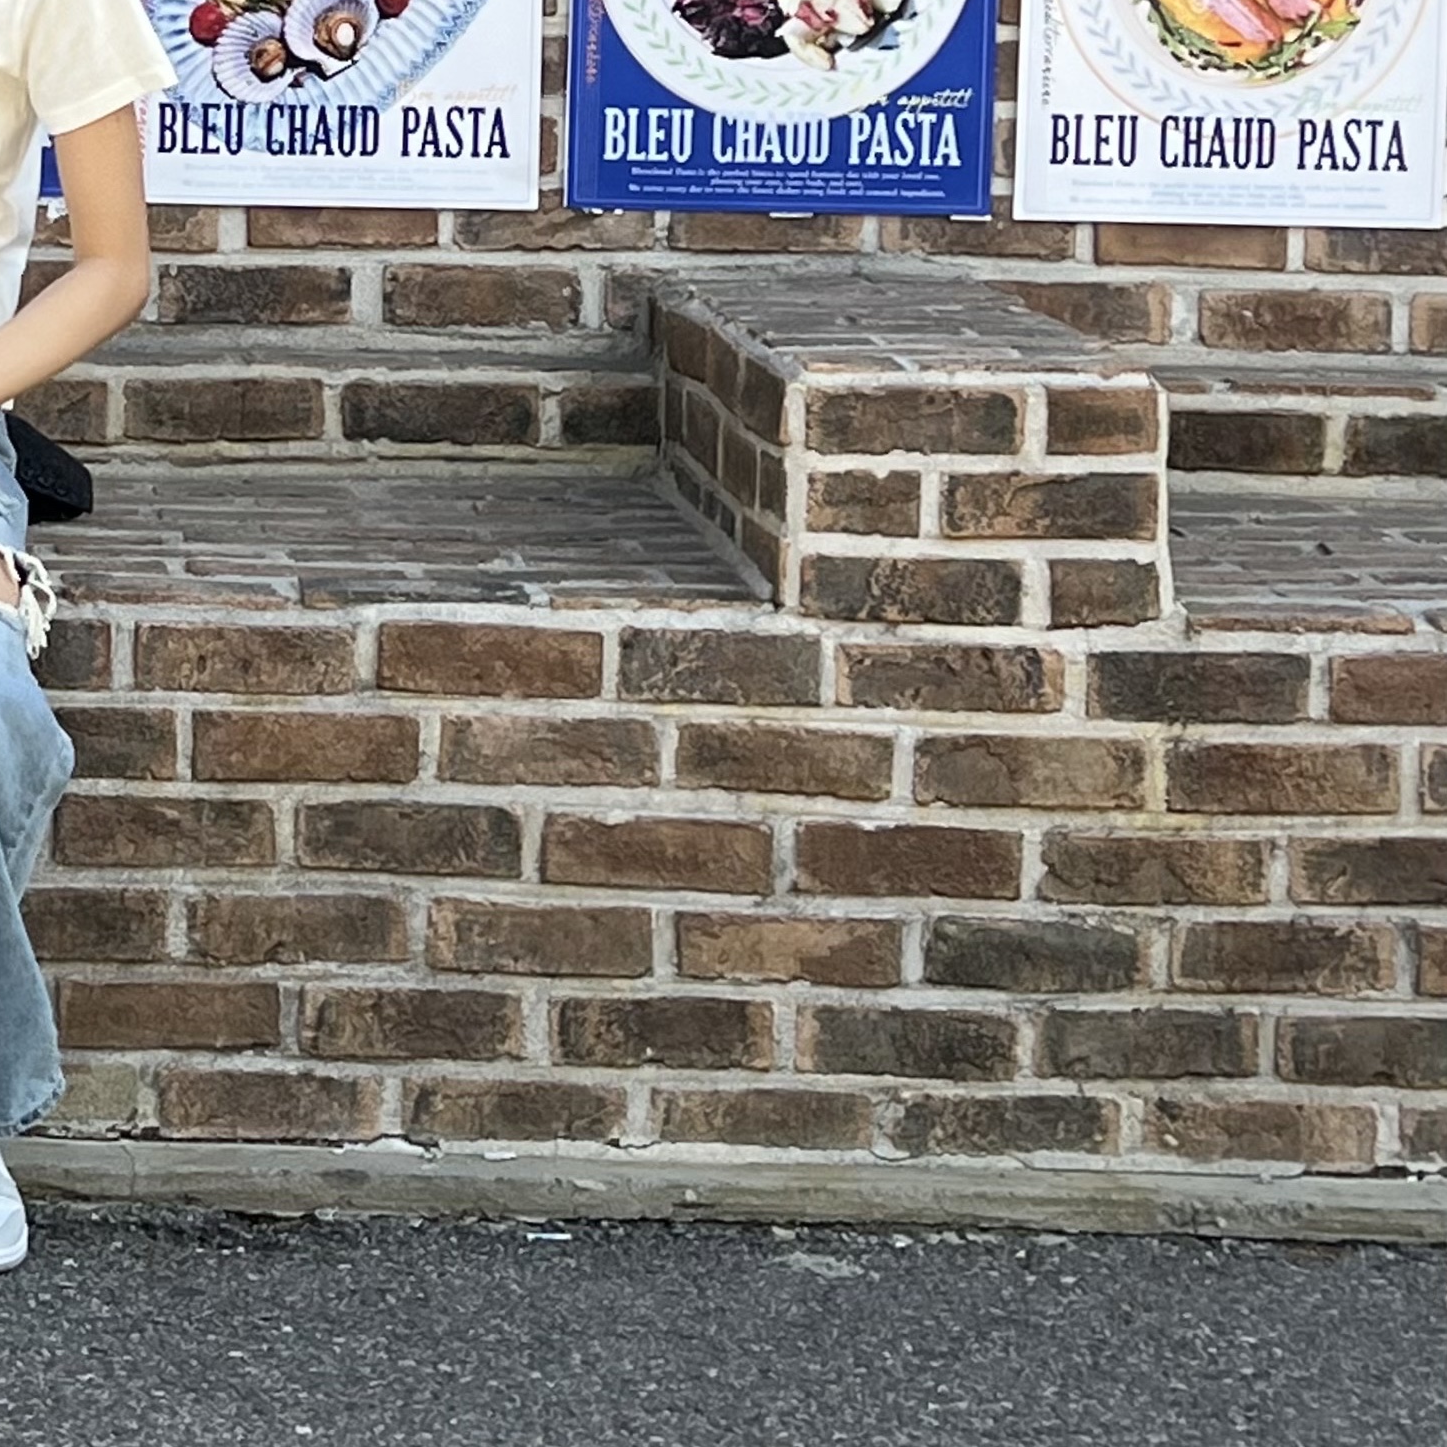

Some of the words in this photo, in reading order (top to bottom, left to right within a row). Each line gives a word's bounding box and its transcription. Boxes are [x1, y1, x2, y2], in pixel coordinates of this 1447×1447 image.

[157, 102, 245, 155] BLEU
[264, 102, 381, 157] CHAUD
[400, 105, 511, 159] PASTA
[602, 106, 695, 163] BLEU
[711, 109, 832, 165] CHAUD
[847, 110, 963, 167] PASTA
[1049, 113, 1139, 167] BLEU
[1158, 114, 1276, 170] CHAUD
[1296, 118, 1409, 173] PASTA
